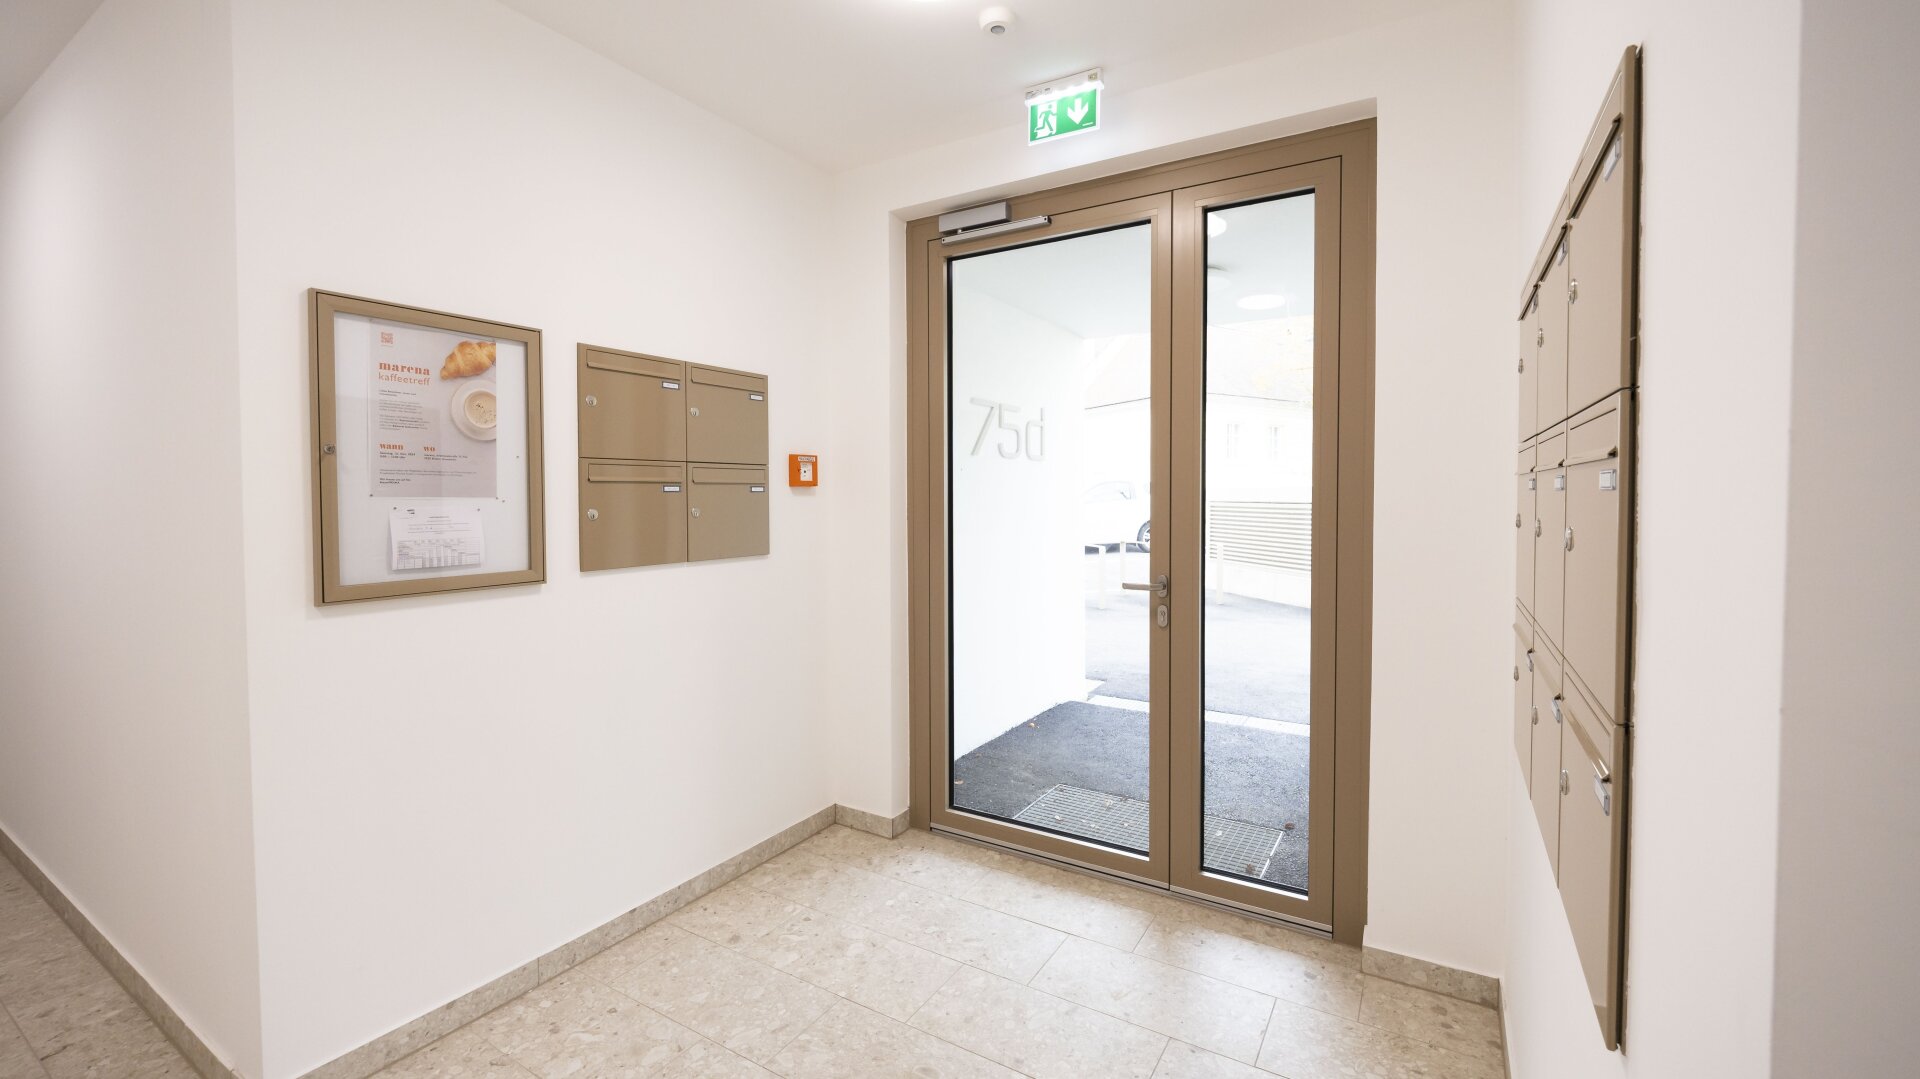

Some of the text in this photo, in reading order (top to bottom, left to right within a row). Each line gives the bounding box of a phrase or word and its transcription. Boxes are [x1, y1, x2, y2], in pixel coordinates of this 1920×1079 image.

[378, 362, 430, 376] marena
[378, 372, 431, 386] kaffeetreff
[969, 397, 1045, 462] 75d
